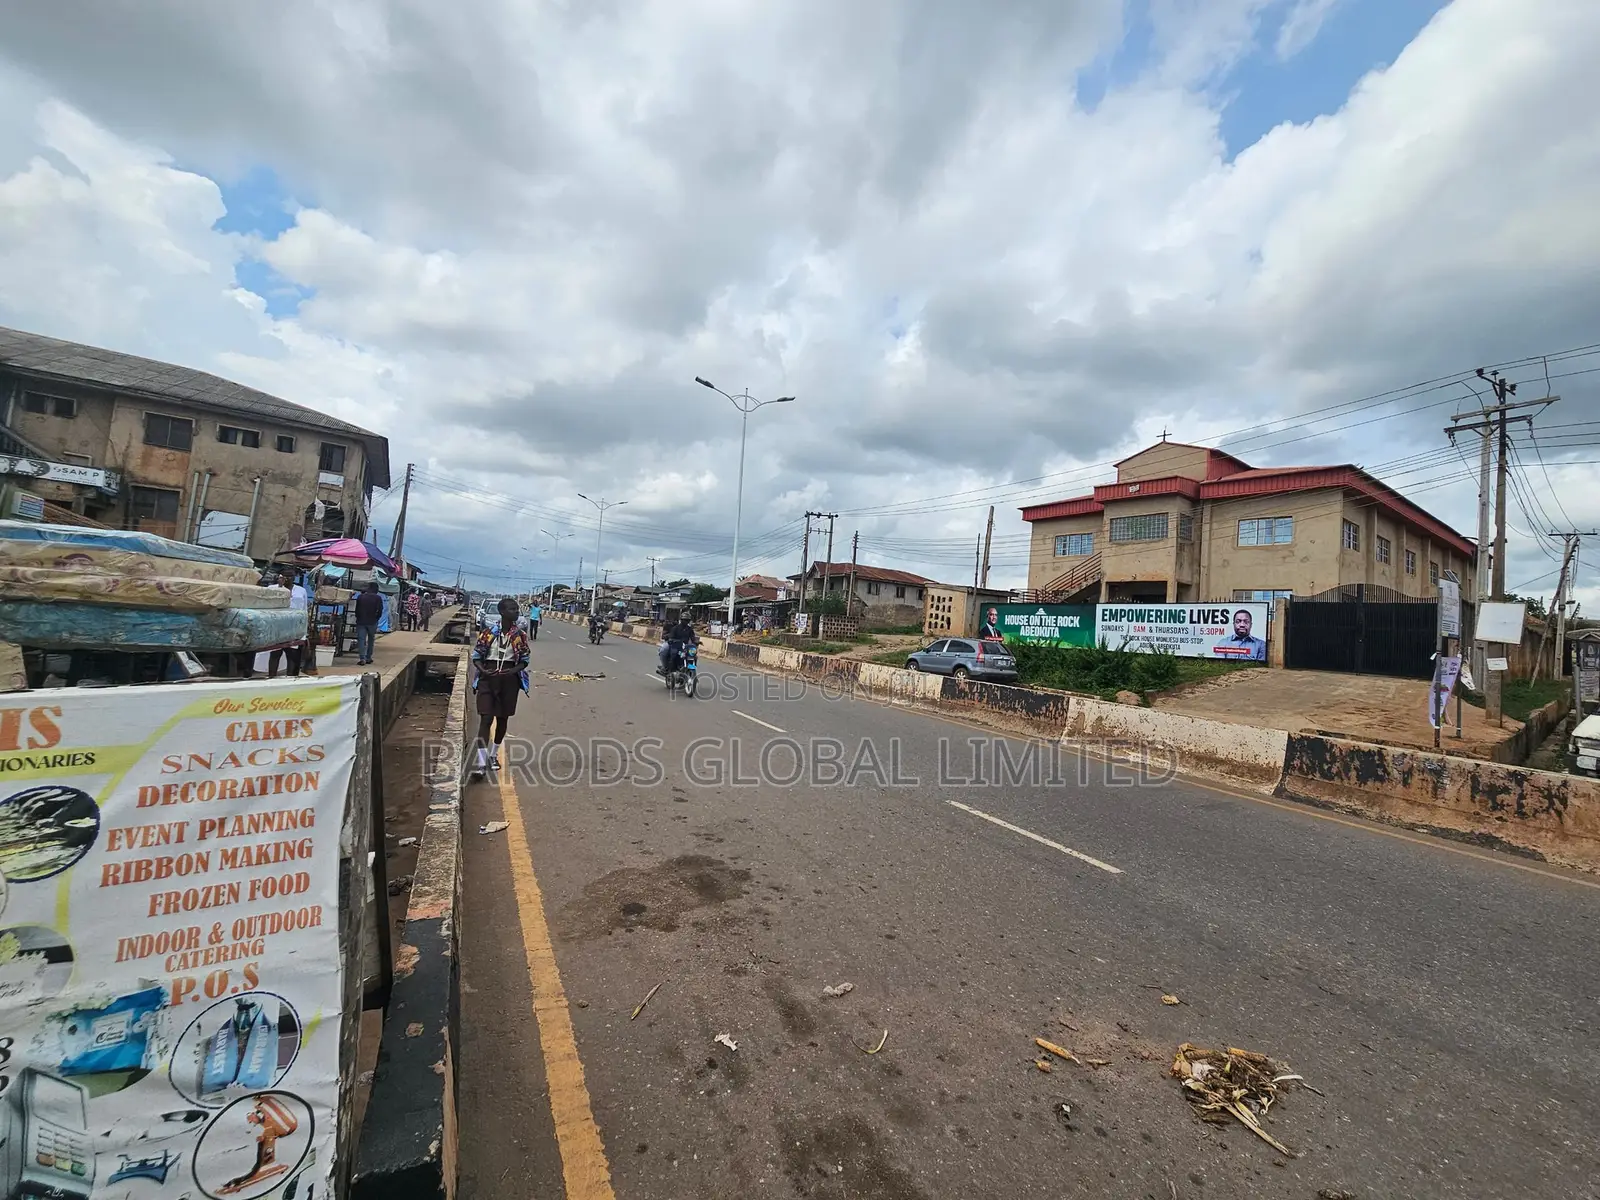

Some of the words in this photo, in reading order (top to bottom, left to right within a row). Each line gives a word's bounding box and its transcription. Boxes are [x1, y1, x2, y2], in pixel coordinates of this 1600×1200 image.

[1005, 615, 1029, 625] HOUSE
[1030, 615, 1040, 626] ON
[1041, 615, 1056, 627] THE
[1057, 616, 1080, 627] ROCK
[1020, 626, 1060, 638] ABEOKUTA
[1101, 624, 1124, 633] SUNDAYS
[1133, 625, 1146, 633] 9AM
[1148, 626, 1153, 634] &
[1155, 626, 1189, 635] THURSDAYS
[1200, 627, 1225, 636] 5:30PM
[1102, 608, 1186, 624] EMPOWERING
[1189, 609, 1230, 624] LIVES
[213, 699, 244, 714] Our
[248, 697, 307, 713] Services
[225, 718, 314, 742] CAKES
[160, 744, 326, 775] SNACKS
[136, 771, 320, 808] DECORATION
[105, 821, 190, 852] EVENT
[197, 807, 316, 841] PLANNING
[99, 851, 211, 888] RIBBON
[218, 838, 314, 871] MAKING
[147, 882, 242, 918] FROZEN
[247, 871, 311, 902] FOOD
[115, 926, 201, 963] INDOOR
[207, 921, 226, 945] &
[231, 905, 323, 941] OUTDOOR
[164, 938, 265, 973] CATERING
[212, 1028, 229, 1076] HARVEST
